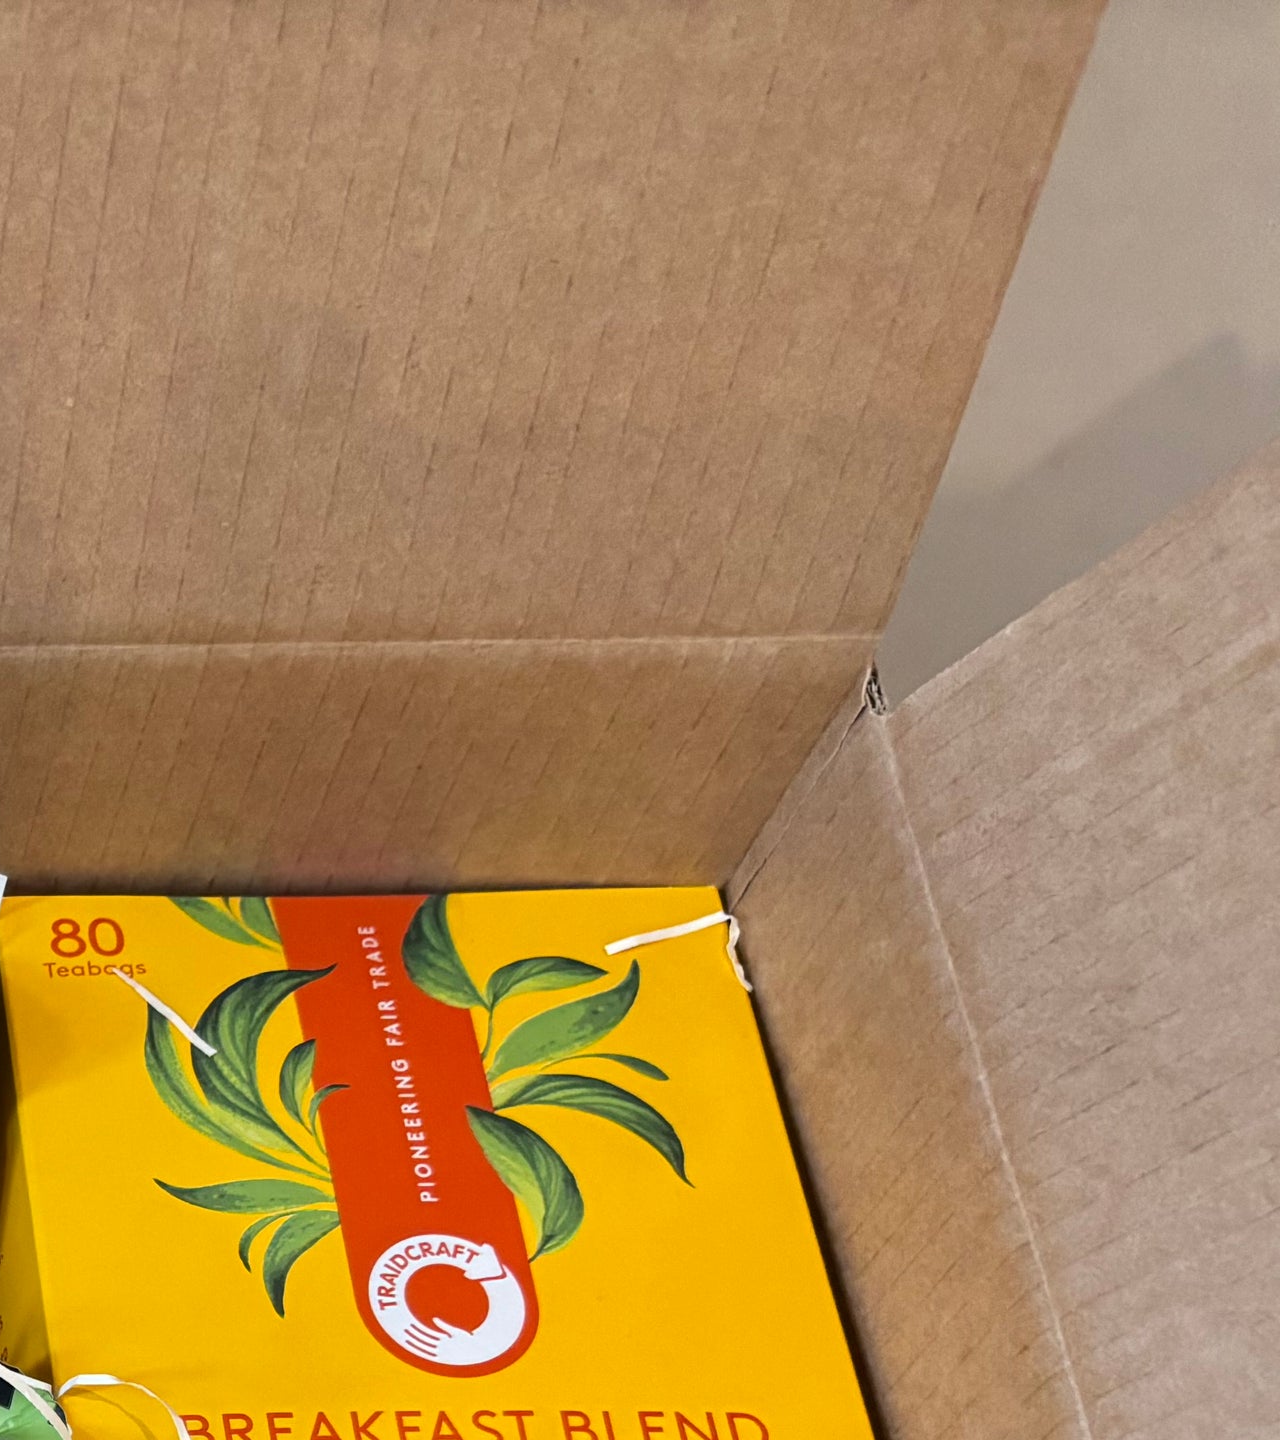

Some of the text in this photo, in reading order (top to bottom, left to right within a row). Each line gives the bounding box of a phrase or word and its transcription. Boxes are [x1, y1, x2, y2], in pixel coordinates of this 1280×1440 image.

[51, 917, 124, 958] 80
[43, 961, 146, 979] Teabags
[357, 925, 439, 1203] PIONEERING FAIR TRADE
[376, 1241, 480, 1311] TRAIDCRAFT
